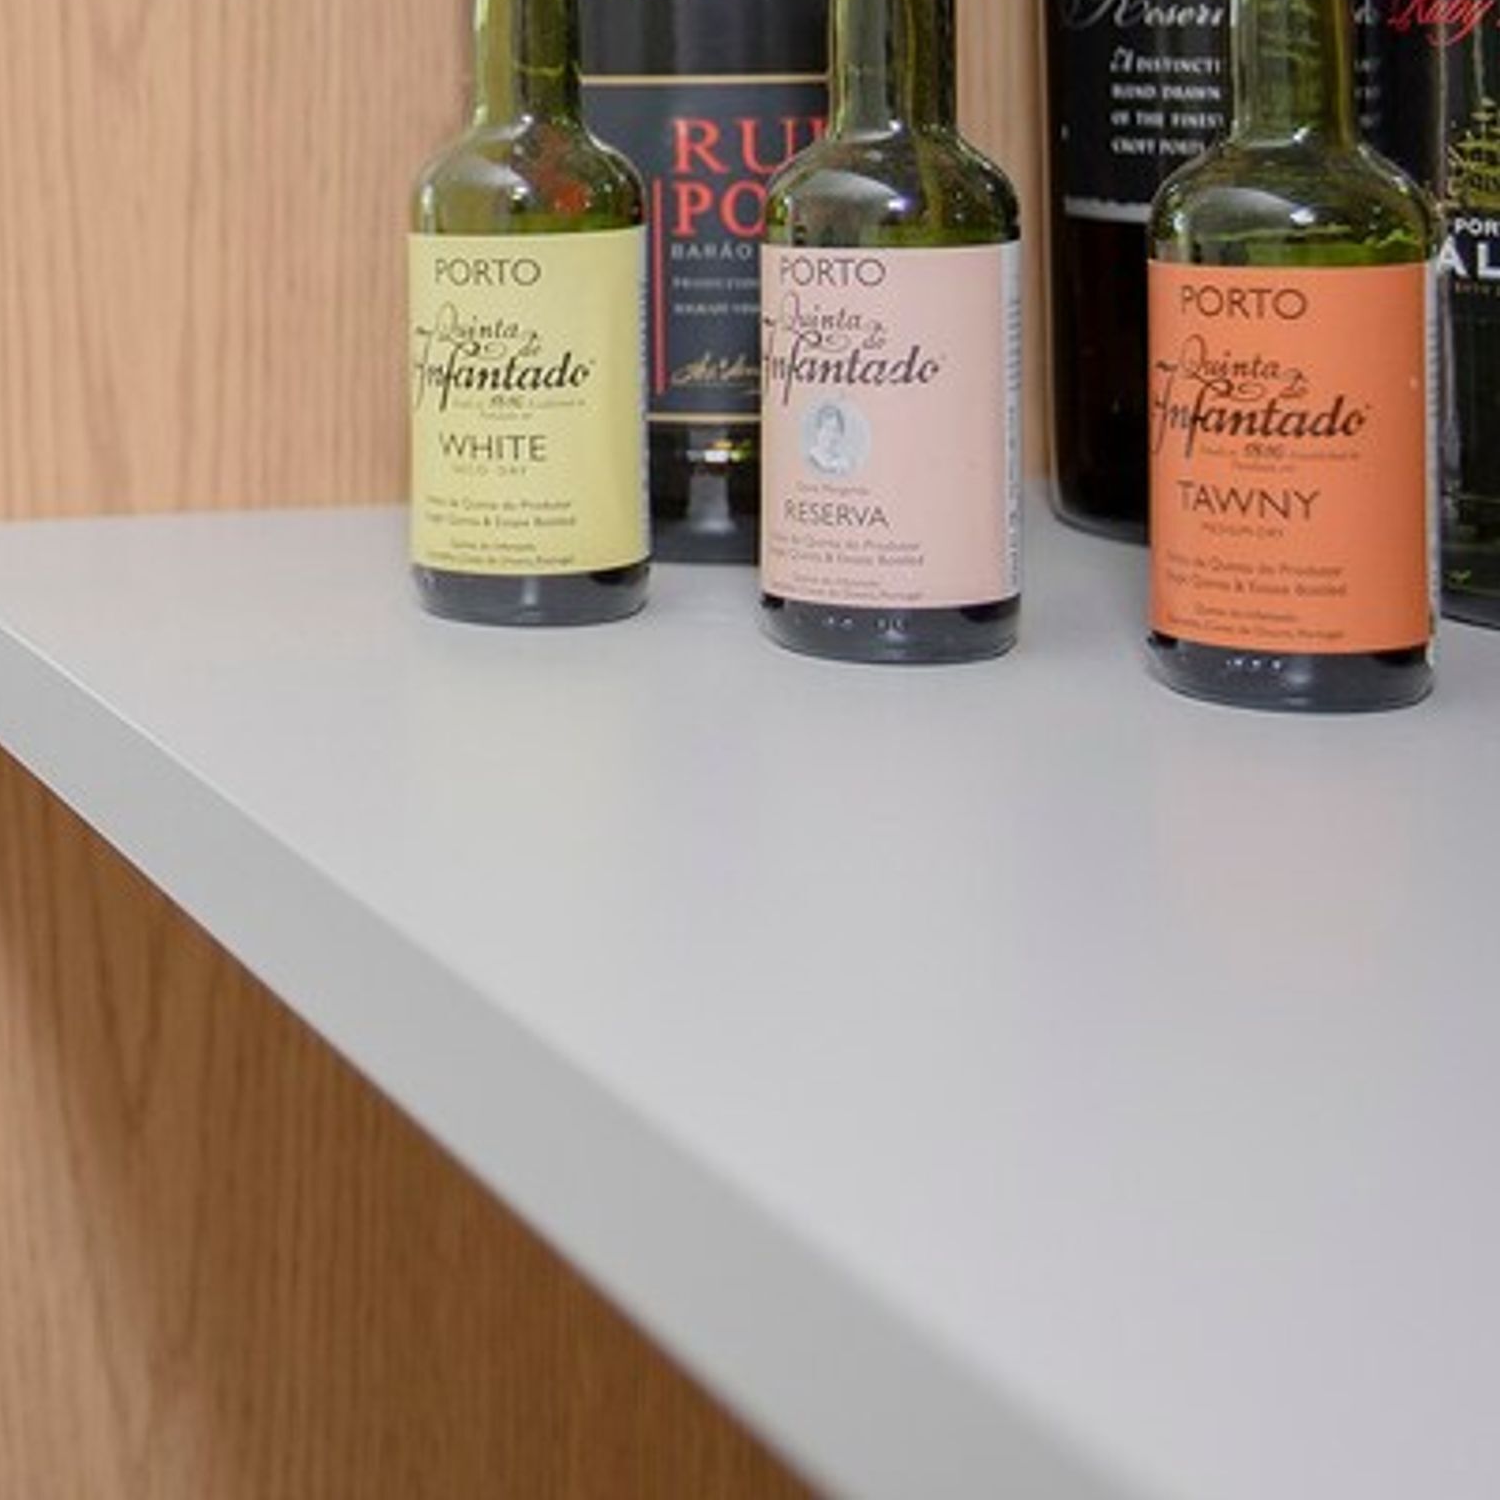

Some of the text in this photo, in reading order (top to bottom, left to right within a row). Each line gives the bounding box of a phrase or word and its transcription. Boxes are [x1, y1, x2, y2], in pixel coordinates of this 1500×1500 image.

[434, 257, 542, 287] PORTO
[779, 256, 887, 287] PORTO
[435, 300, 520, 344] Quinta
[782, 291, 863, 334] Quinta
[1181, 283, 1308, 321] PORTO
[413, 325, 591, 412] Infantado
[762, 316, 940, 407] Infantado
[1177, 333, 1282, 380] Quinta
[1154, 360, 1367, 460] Infantado
[438, 432, 547, 462] WHITE
[783, 499, 890, 529] RESERVA
[1176, 478, 1322, 522] TAWNY
